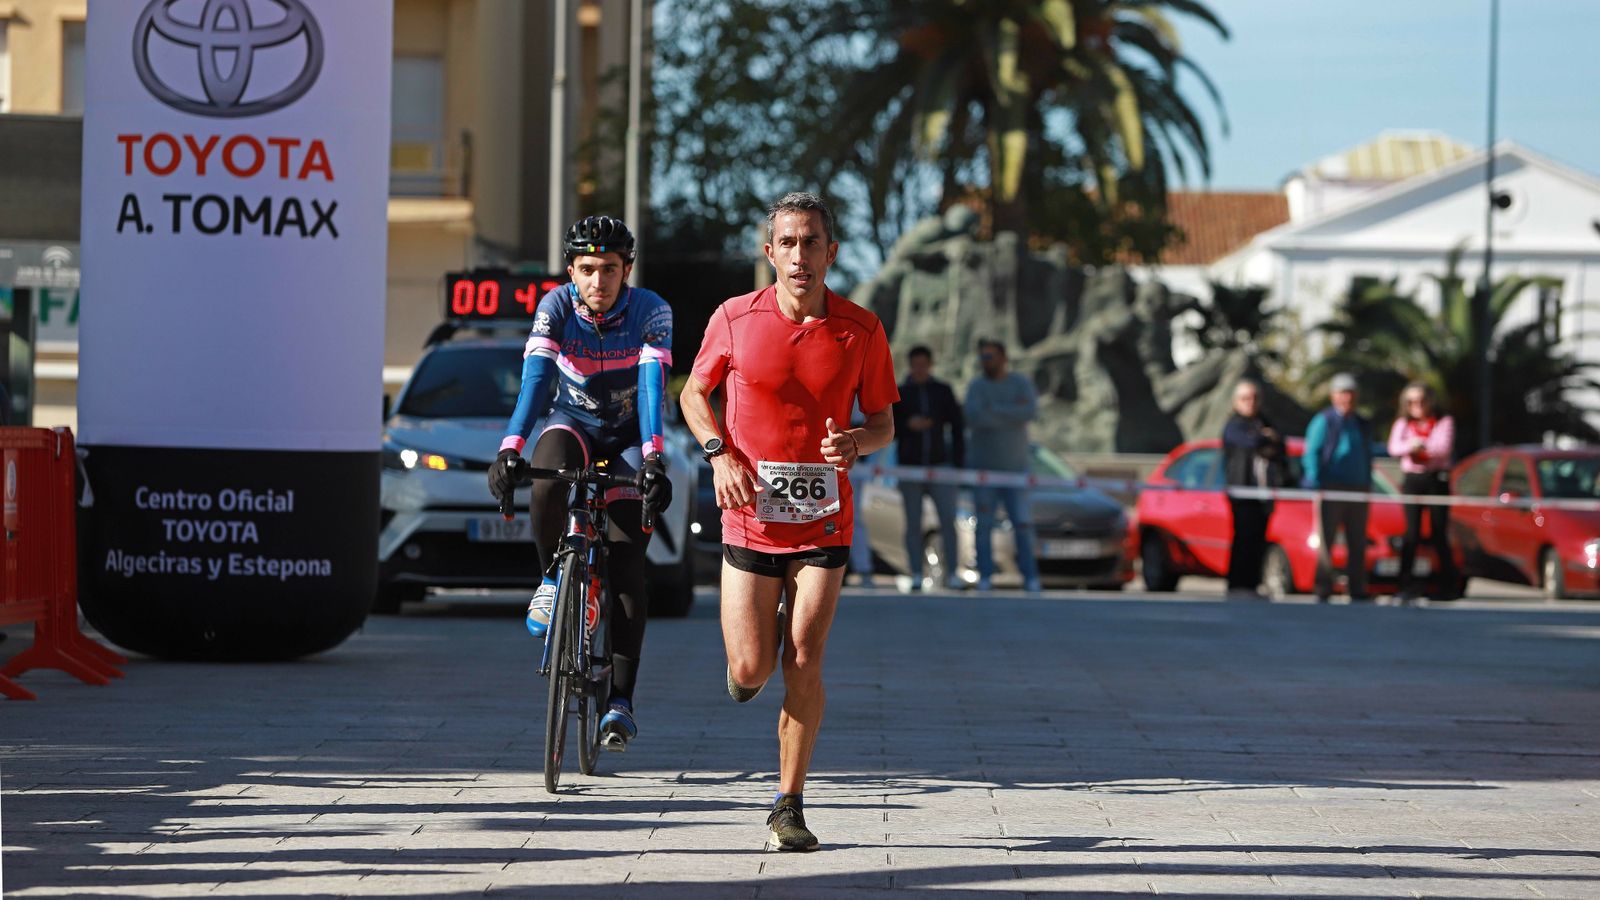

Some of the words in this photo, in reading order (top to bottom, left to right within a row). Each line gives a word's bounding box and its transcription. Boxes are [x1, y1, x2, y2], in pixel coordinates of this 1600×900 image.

[116, 132, 335, 182] TOYOTA
[116, 192, 154, 235] A.
[162, 193, 339, 239] TOMAX
[452, 280, 500, 315] 00
[135, 486, 212, 511] Centro
[218, 488, 294, 513] Oficial
[771, 477, 826, 500] 266
[162, 518, 259, 543] TOYOTA
[105, 549, 203, 578] Algeciras
[207, 557, 223, 581] y
[228, 552, 332, 582] Estepona
